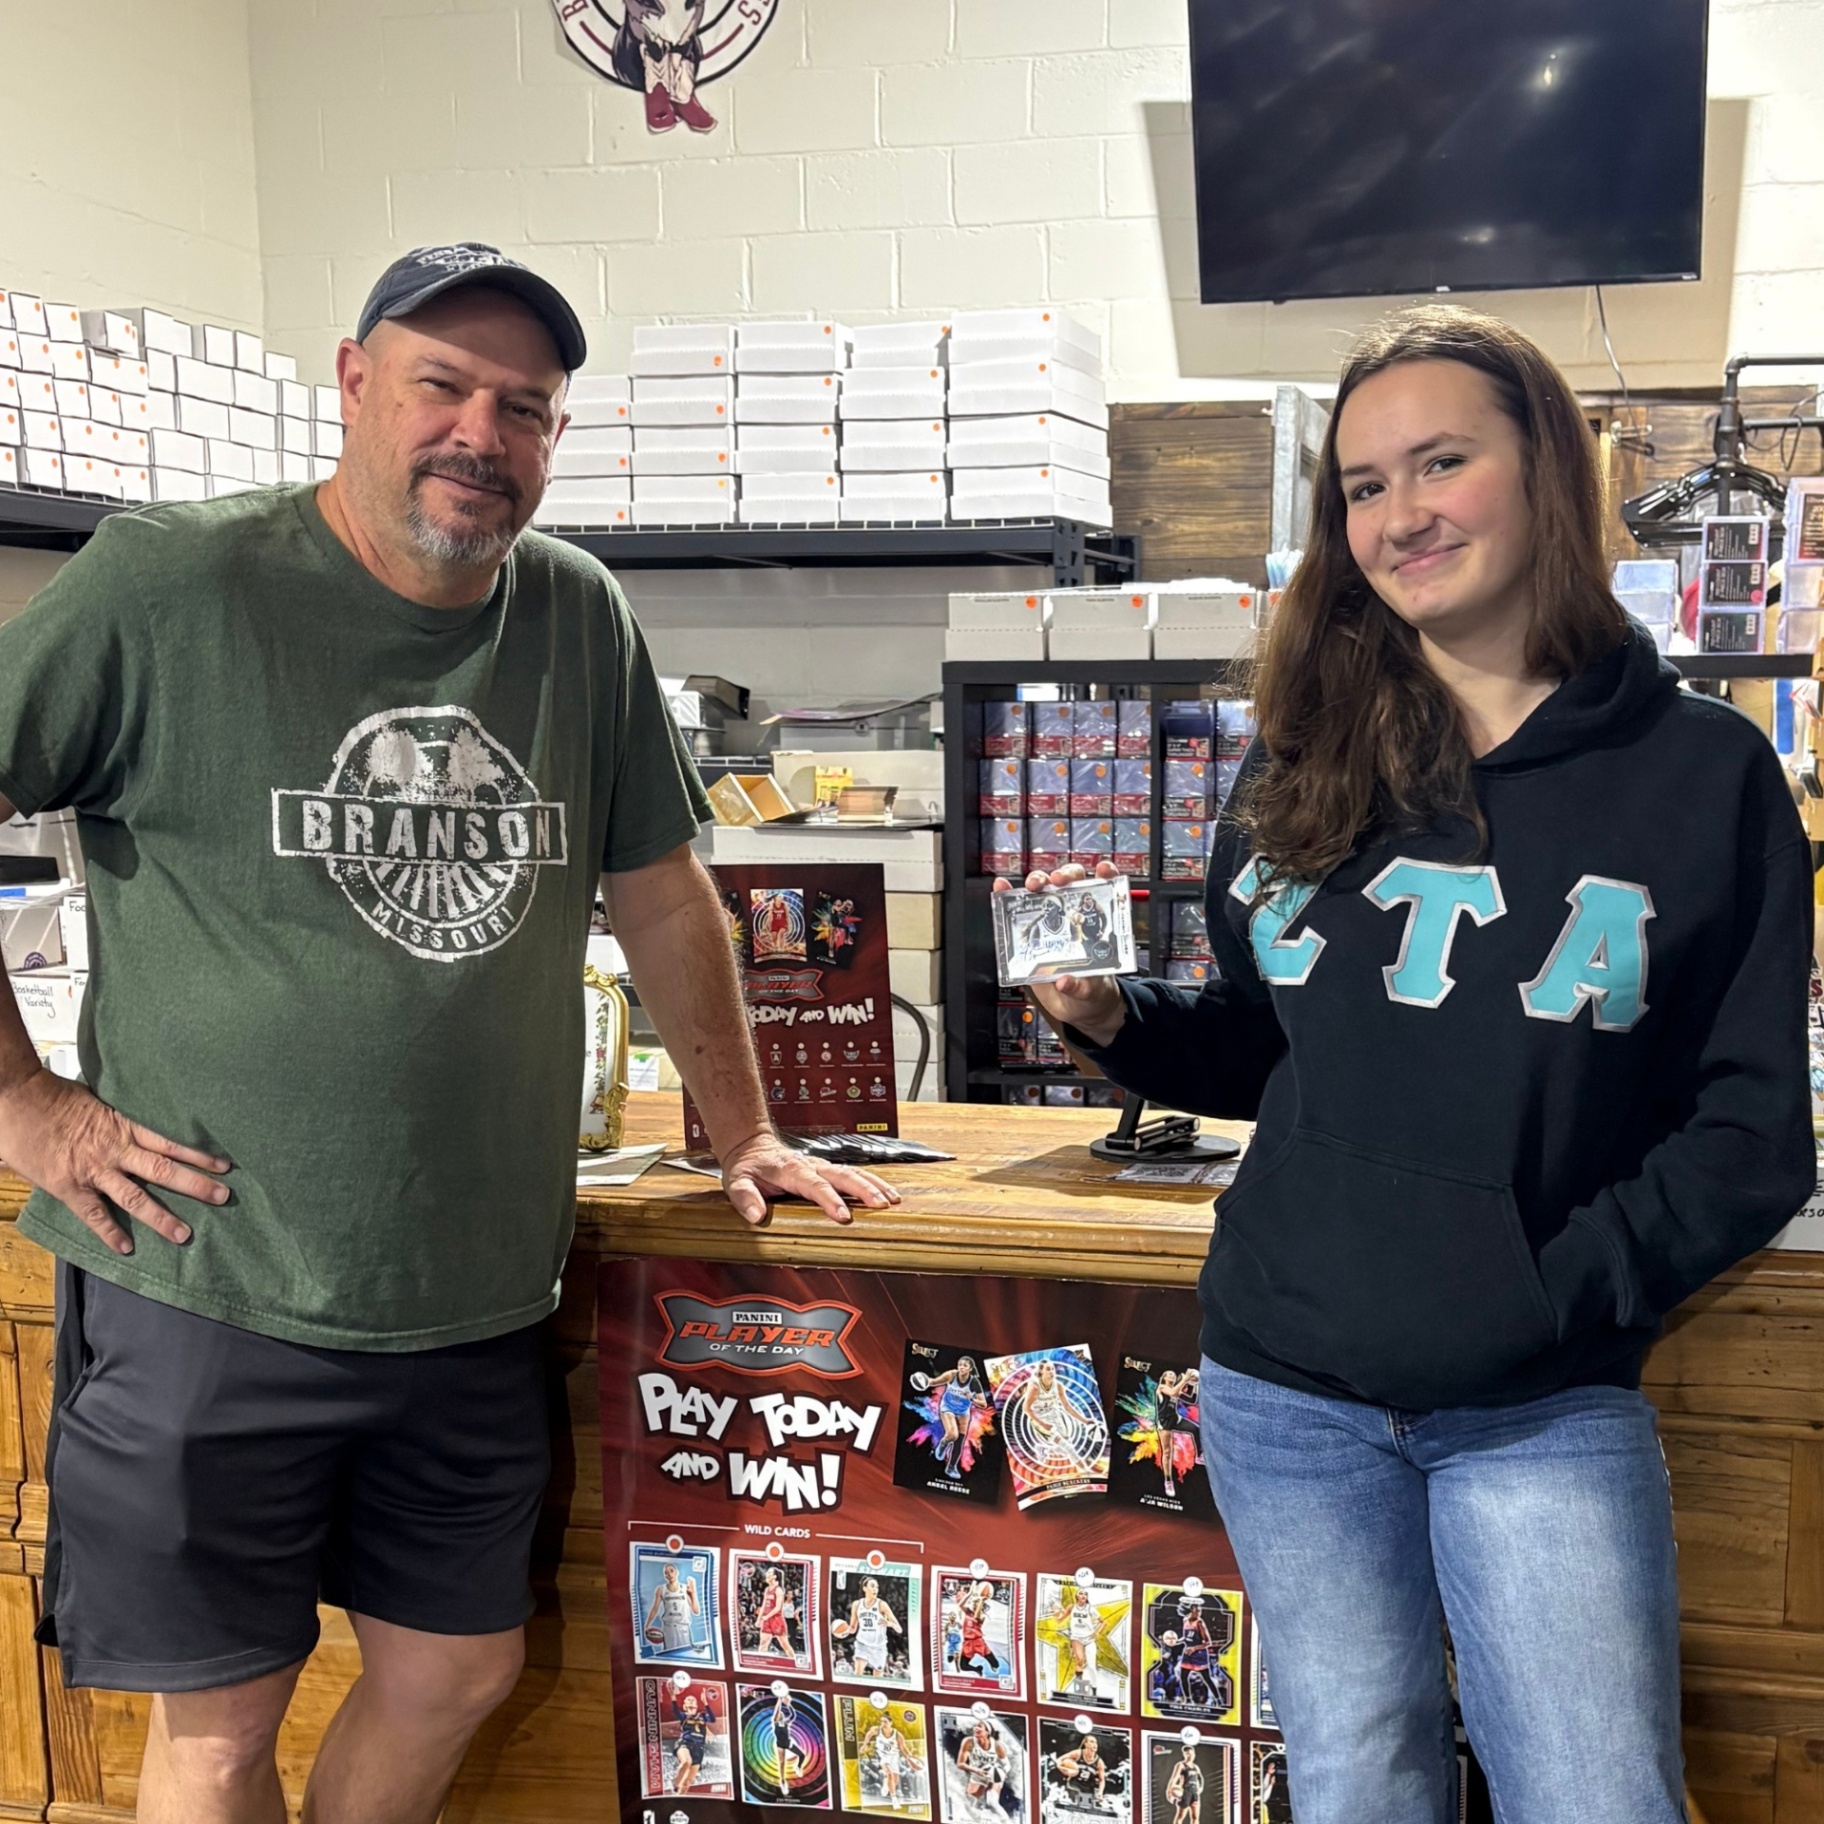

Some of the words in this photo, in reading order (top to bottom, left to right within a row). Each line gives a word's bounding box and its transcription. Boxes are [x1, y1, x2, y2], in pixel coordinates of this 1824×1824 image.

[302, 799, 551, 859] BRANSON
[370, 899, 516, 949] MISSOURI
[1228, 853, 1658, 1034] ZTA
[799, 1009, 824, 1023] AND
[826, 998, 875, 1025] WIN!
[859, 1124, 886, 1132] PANINI
[678, 1321, 836, 1348] PLAYER
[734, 1312, 780, 1324] PANINI
[709, 1342, 731, 1352] OF
[734, 1344, 768, 1354] THE
[771, 1346, 805, 1356] DAY
[637, 1372, 739, 1441] PLAY
[749, 1392, 882, 1451] TODAY
[660, 1451, 720, 1480] AND
[728, 1452, 841, 1511] WIN!
[744, 1524, 772, 1537] WILD
[774, 1526, 811, 1539] CARDS
[842, 1698, 856, 1742] PLUM
